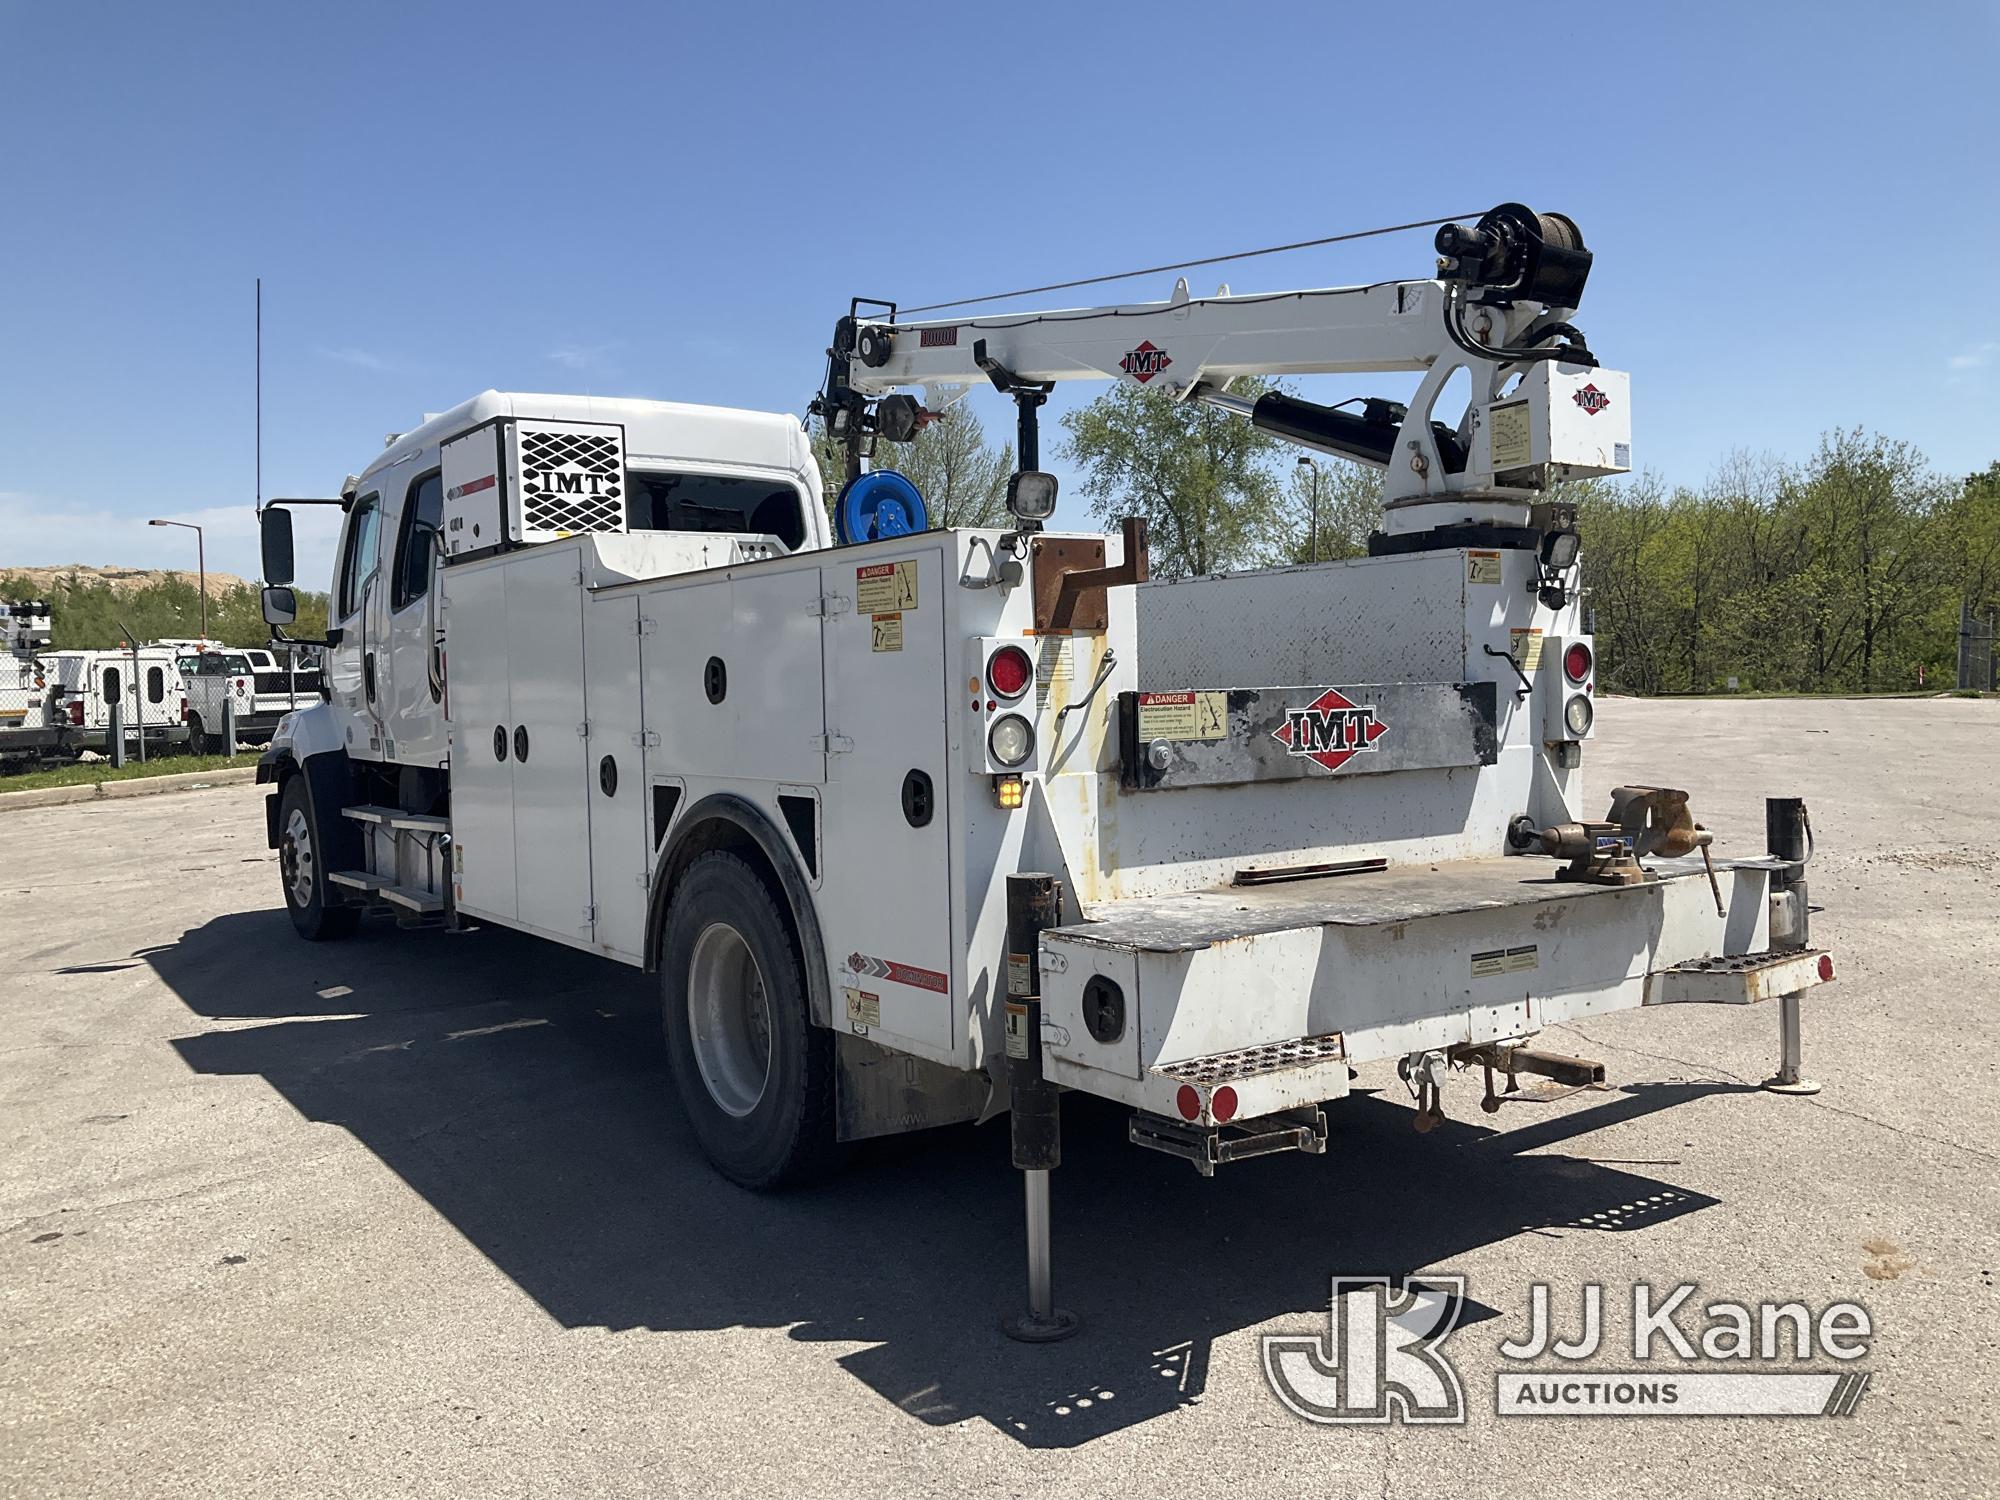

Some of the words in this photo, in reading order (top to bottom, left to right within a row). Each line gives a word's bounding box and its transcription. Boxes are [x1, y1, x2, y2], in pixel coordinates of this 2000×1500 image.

[1125, 351, 1166, 373] IMT
[1576, 390, 1606, 409] IMT
[541, 471, 604, 495] IMT
[866, 565, 890, 577] DANGER
[1155, 695, 1188, 704] DANGER
[1289, 709, 1374, 752] IMT
